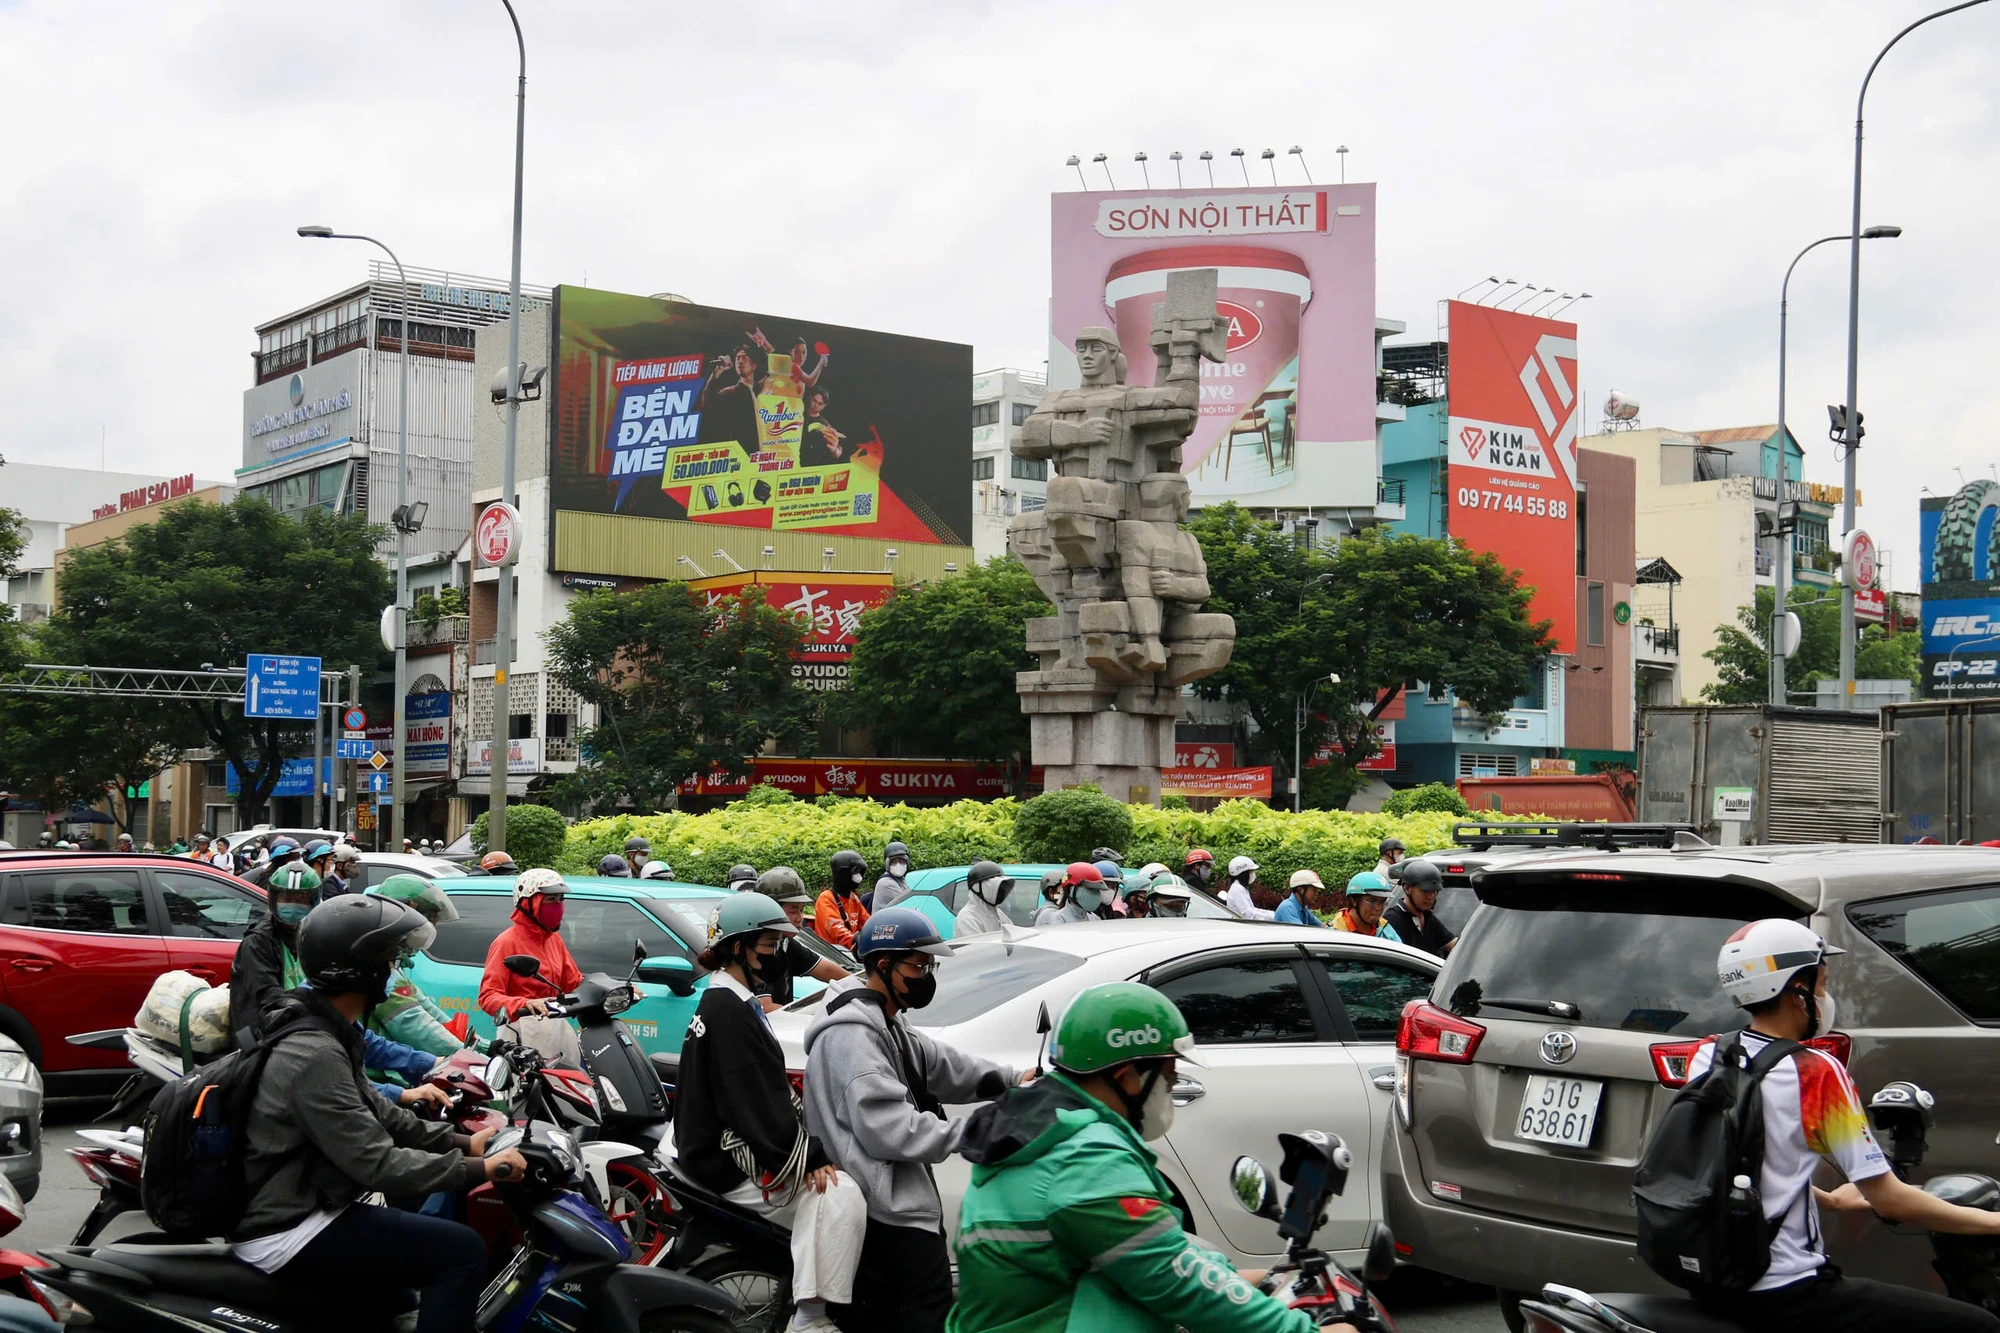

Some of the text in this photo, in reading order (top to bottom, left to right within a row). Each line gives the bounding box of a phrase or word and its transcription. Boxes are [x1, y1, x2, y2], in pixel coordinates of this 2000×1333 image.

[1108, 194, 1311, 233] SƠN NỘI THẤT
[616, 359, 700, 382] TIẾP NĂNG LƯỢNG
[622, 386, 692, 420] BỀN
[759, 407, 799, 424] Number
[617, 414, 700, 446] ĐAM
[1489, 430, 1523, 450] KIM
[612, 441, 667, 475] MÊ
[1489, 448, 1541, 470] NGAN
[148, 481, 169, 503] SAO
[170, 473, 194, 498] NAM
[1489, 477, 1540, 490] LIÊN HỆ QUẢNG CÁO
[1755, 477, 1776, 498] MINH
[1458, 488, 1567, 519] 09 77 44 55 88
[574, 578, 617, 588] PROWTECH
[803, 643, 847, 653] SUKIYA
[790, 665, 851, 678] GYUDO
[1932, 660, 1998, 677] GP-22
[406, 727, 421, 743] MAI
[422, 721, 444, 742] HỒNG
[763, 775, 806, 783] GYUDON
[825, 765, 857, 786] すき家
[880, 773, 956, 788] SUKIYA
[1725, 799, 1750, 808] KoolMan
[439, 996, 471, 1011] 1900
[642, 1024, 658, 1038] SM
[1106, 1023, 1162, 1048] Grab
[1542, 1079, 1582, 1109] 51G
[1520, 1106, 1588, 1142] 638.61
[477, 1196, 505, 1205] HONDA
[562, 1282, 582, 1294] SYM
